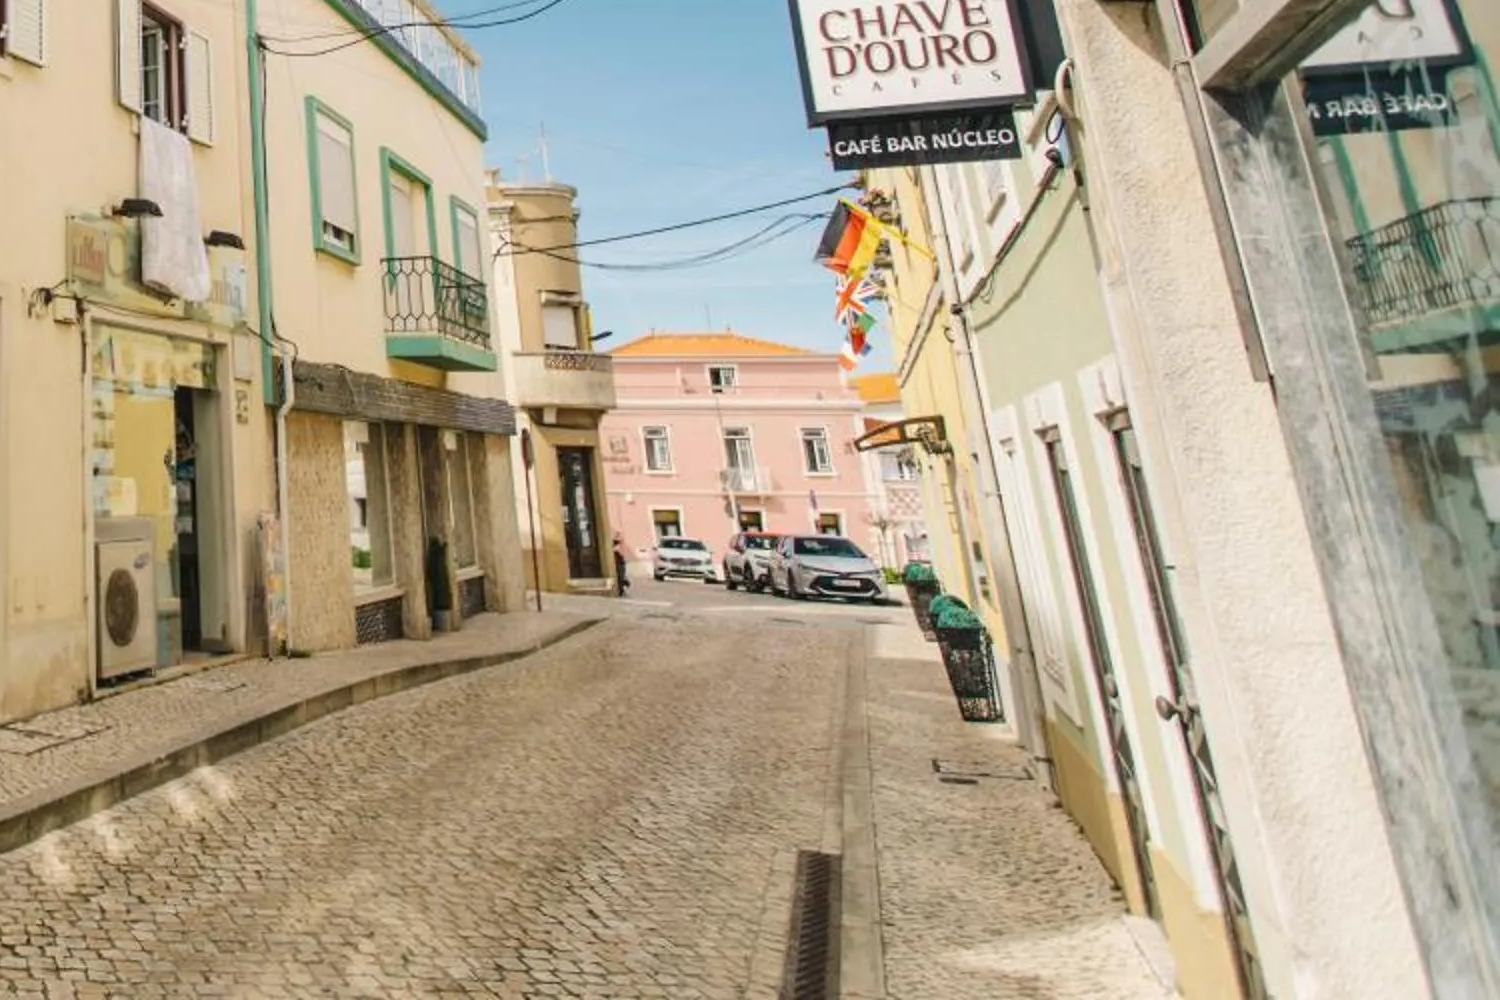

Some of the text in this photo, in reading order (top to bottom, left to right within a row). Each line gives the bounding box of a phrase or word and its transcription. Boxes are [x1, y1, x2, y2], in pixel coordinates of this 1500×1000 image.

[831, 70, 1001, 96] CAFÉS
[833, 128, 1015, 157] CAFÉ BAR NÚCLEO
